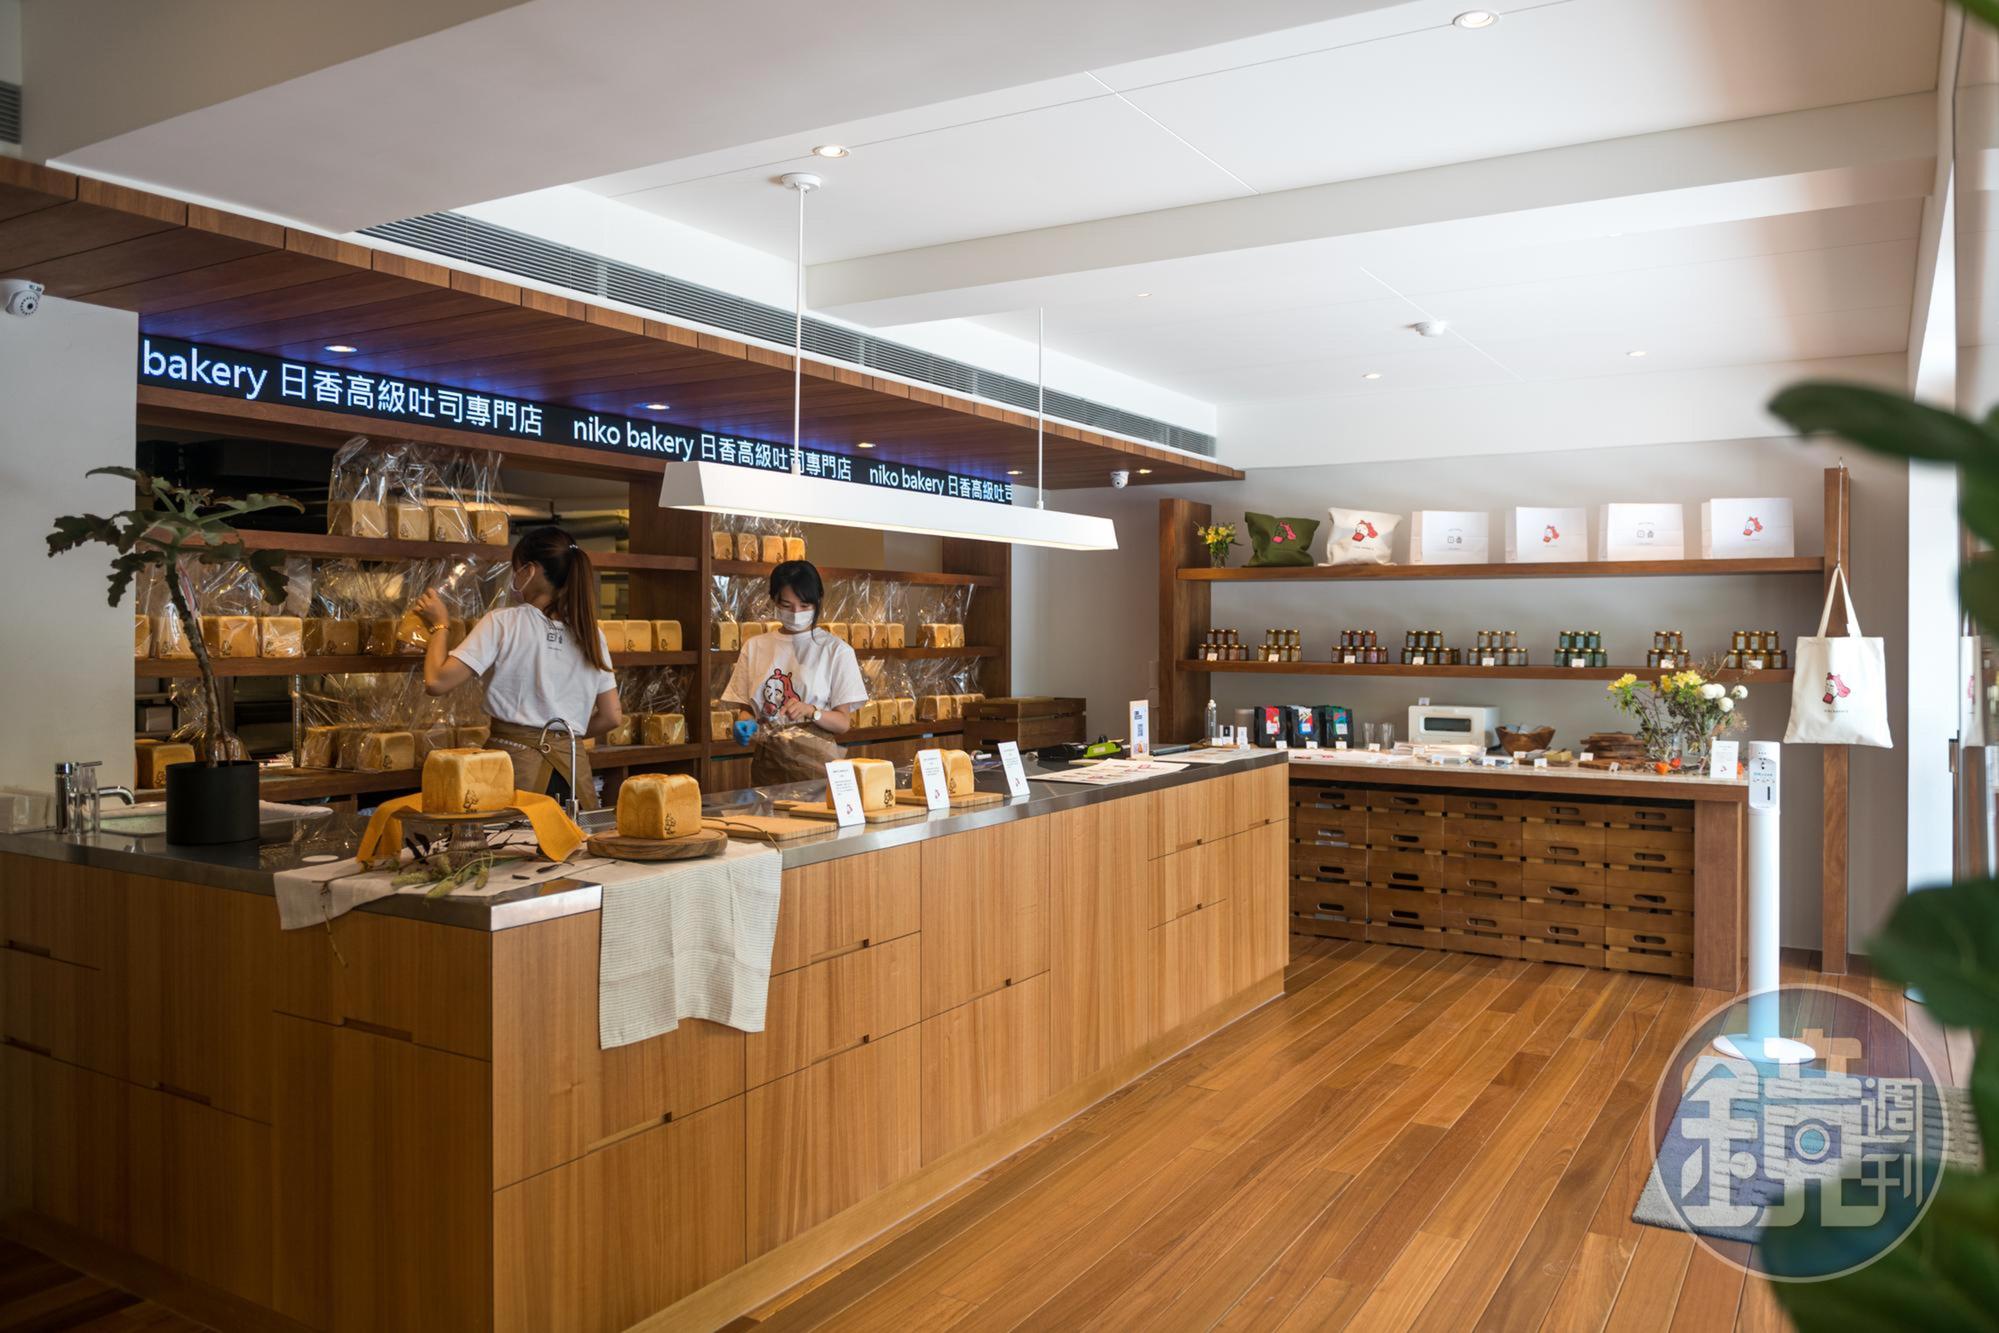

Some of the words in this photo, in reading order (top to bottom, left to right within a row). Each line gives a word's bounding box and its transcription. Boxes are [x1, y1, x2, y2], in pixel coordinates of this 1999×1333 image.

[143, 339, 268, 400] bakery
[281, 362, 543, 437] 日香高級吐司專門店
[573, 416, 621, 445] niko
[626, 421, 695, 462] bakery
[869, 464, 900, 488] niko
[901, 467, 945, 496] bakery
